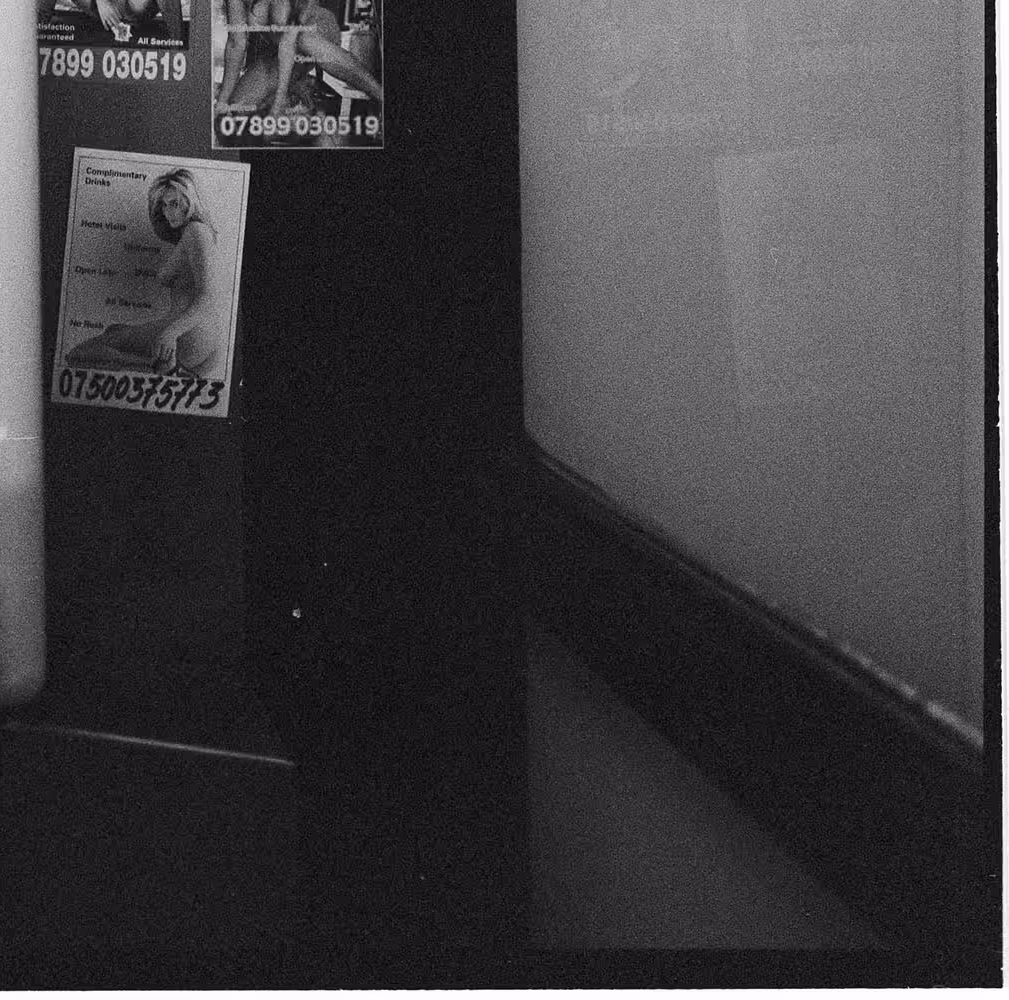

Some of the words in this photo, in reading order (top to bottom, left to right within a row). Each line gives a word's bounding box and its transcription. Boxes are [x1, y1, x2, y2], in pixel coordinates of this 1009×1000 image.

[38, 23, 75, 31] tisfaction
[37, 33, 74, 41] aranteed
[137, 37, 149, 45] All
[150, 37, 184, 46] Services
[39, 46, 95, 78] 7899
[102, 49, 187, 81] 030519
[220, 115, 292, 137] 07899
[295, 115, 380, 137] 030519
[86, 166, 148, 181] Complimentary
[85, 177, 111, 187] Drinks
